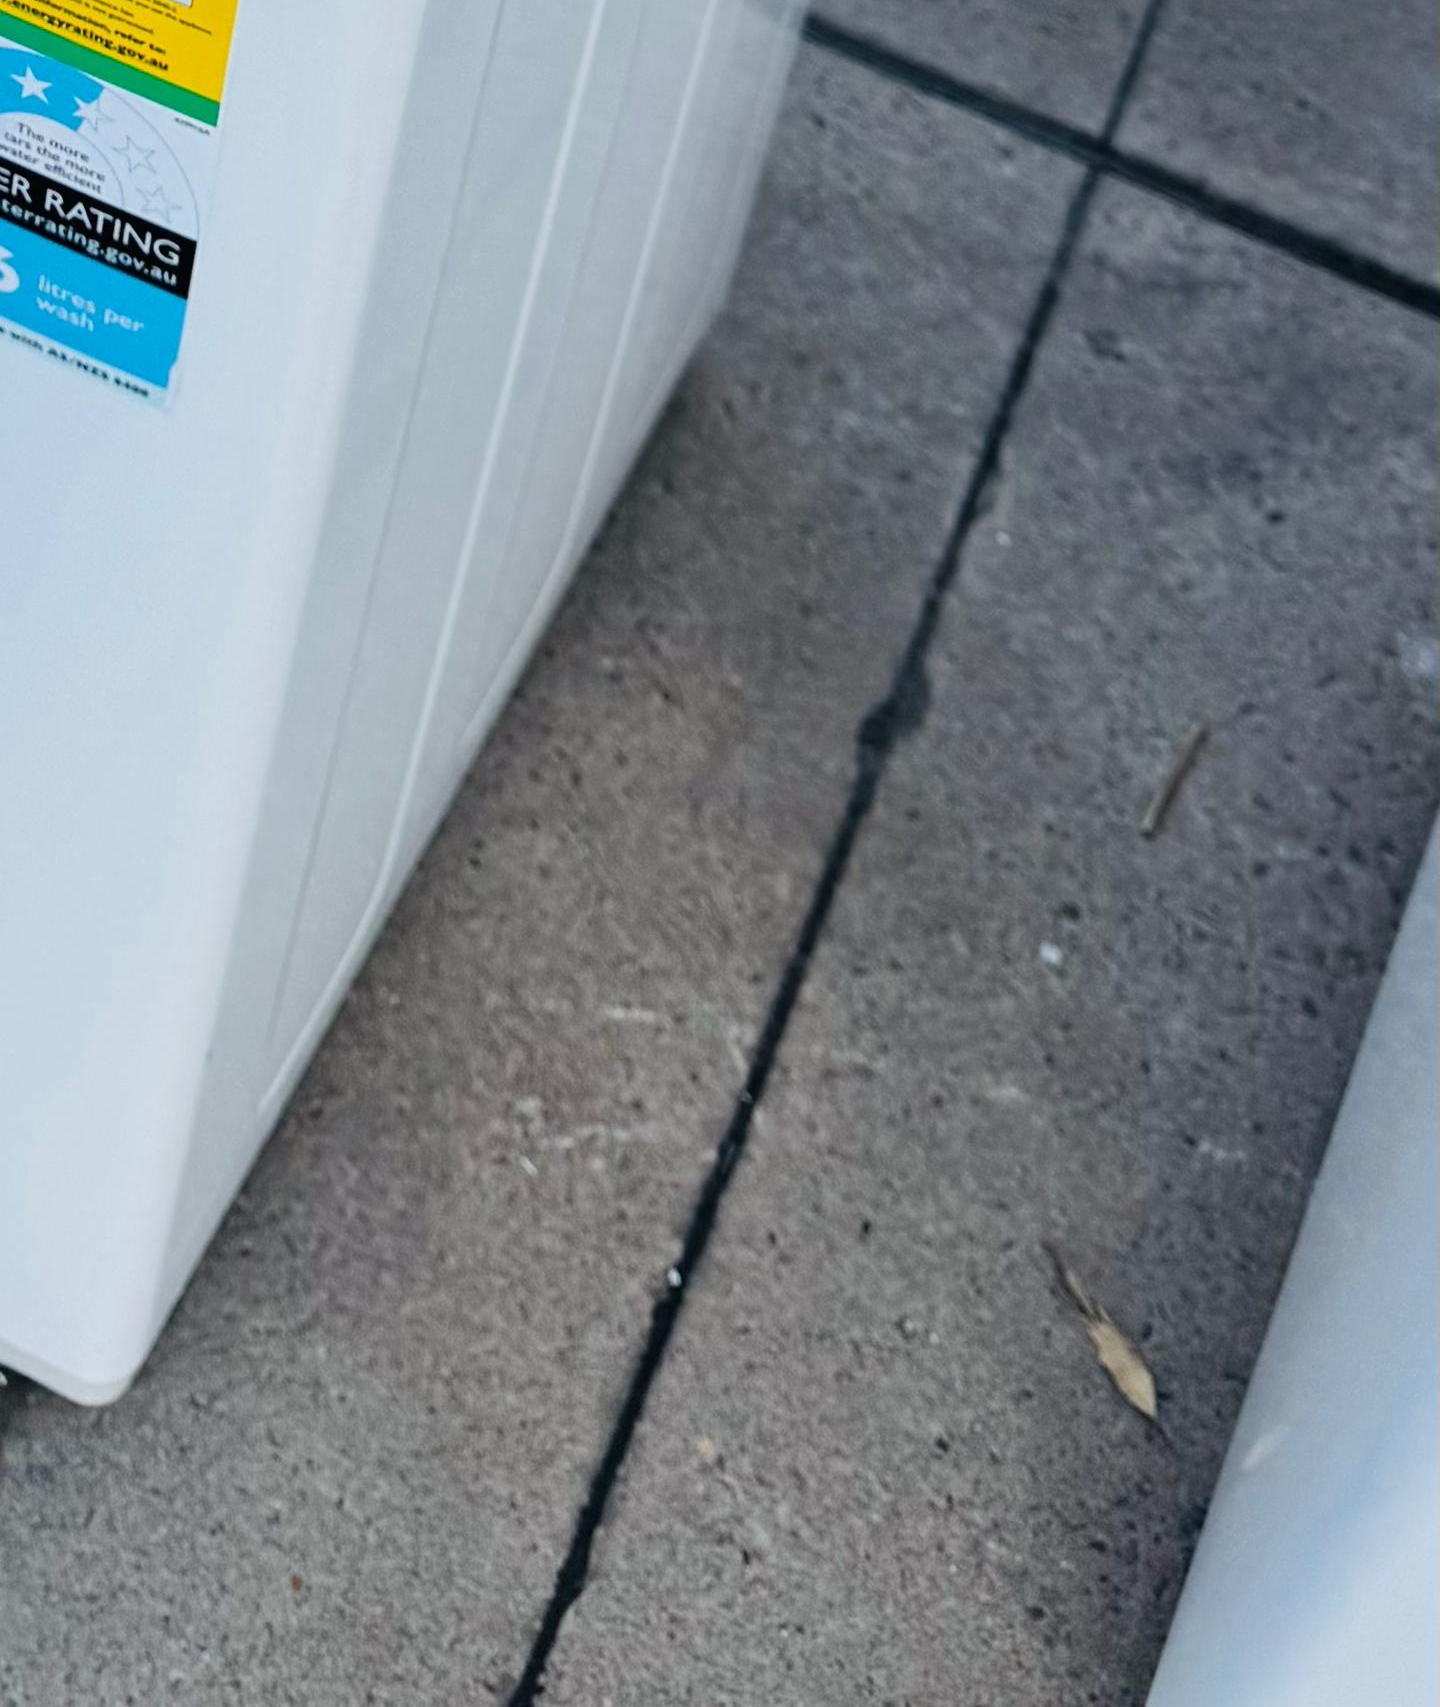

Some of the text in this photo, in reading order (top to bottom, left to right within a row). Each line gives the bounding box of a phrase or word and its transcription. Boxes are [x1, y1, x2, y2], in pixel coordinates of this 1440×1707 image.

[17, 122, 90, 162] The more
[37, 145, 61, 162] the
[65, 158, 106, 182] more
[43, 163, 102, 195] efficient
[44, 188, 181, 267] RATING
[35, 296, 95, 332] wash
[38, 274, 145, 332] litres per
